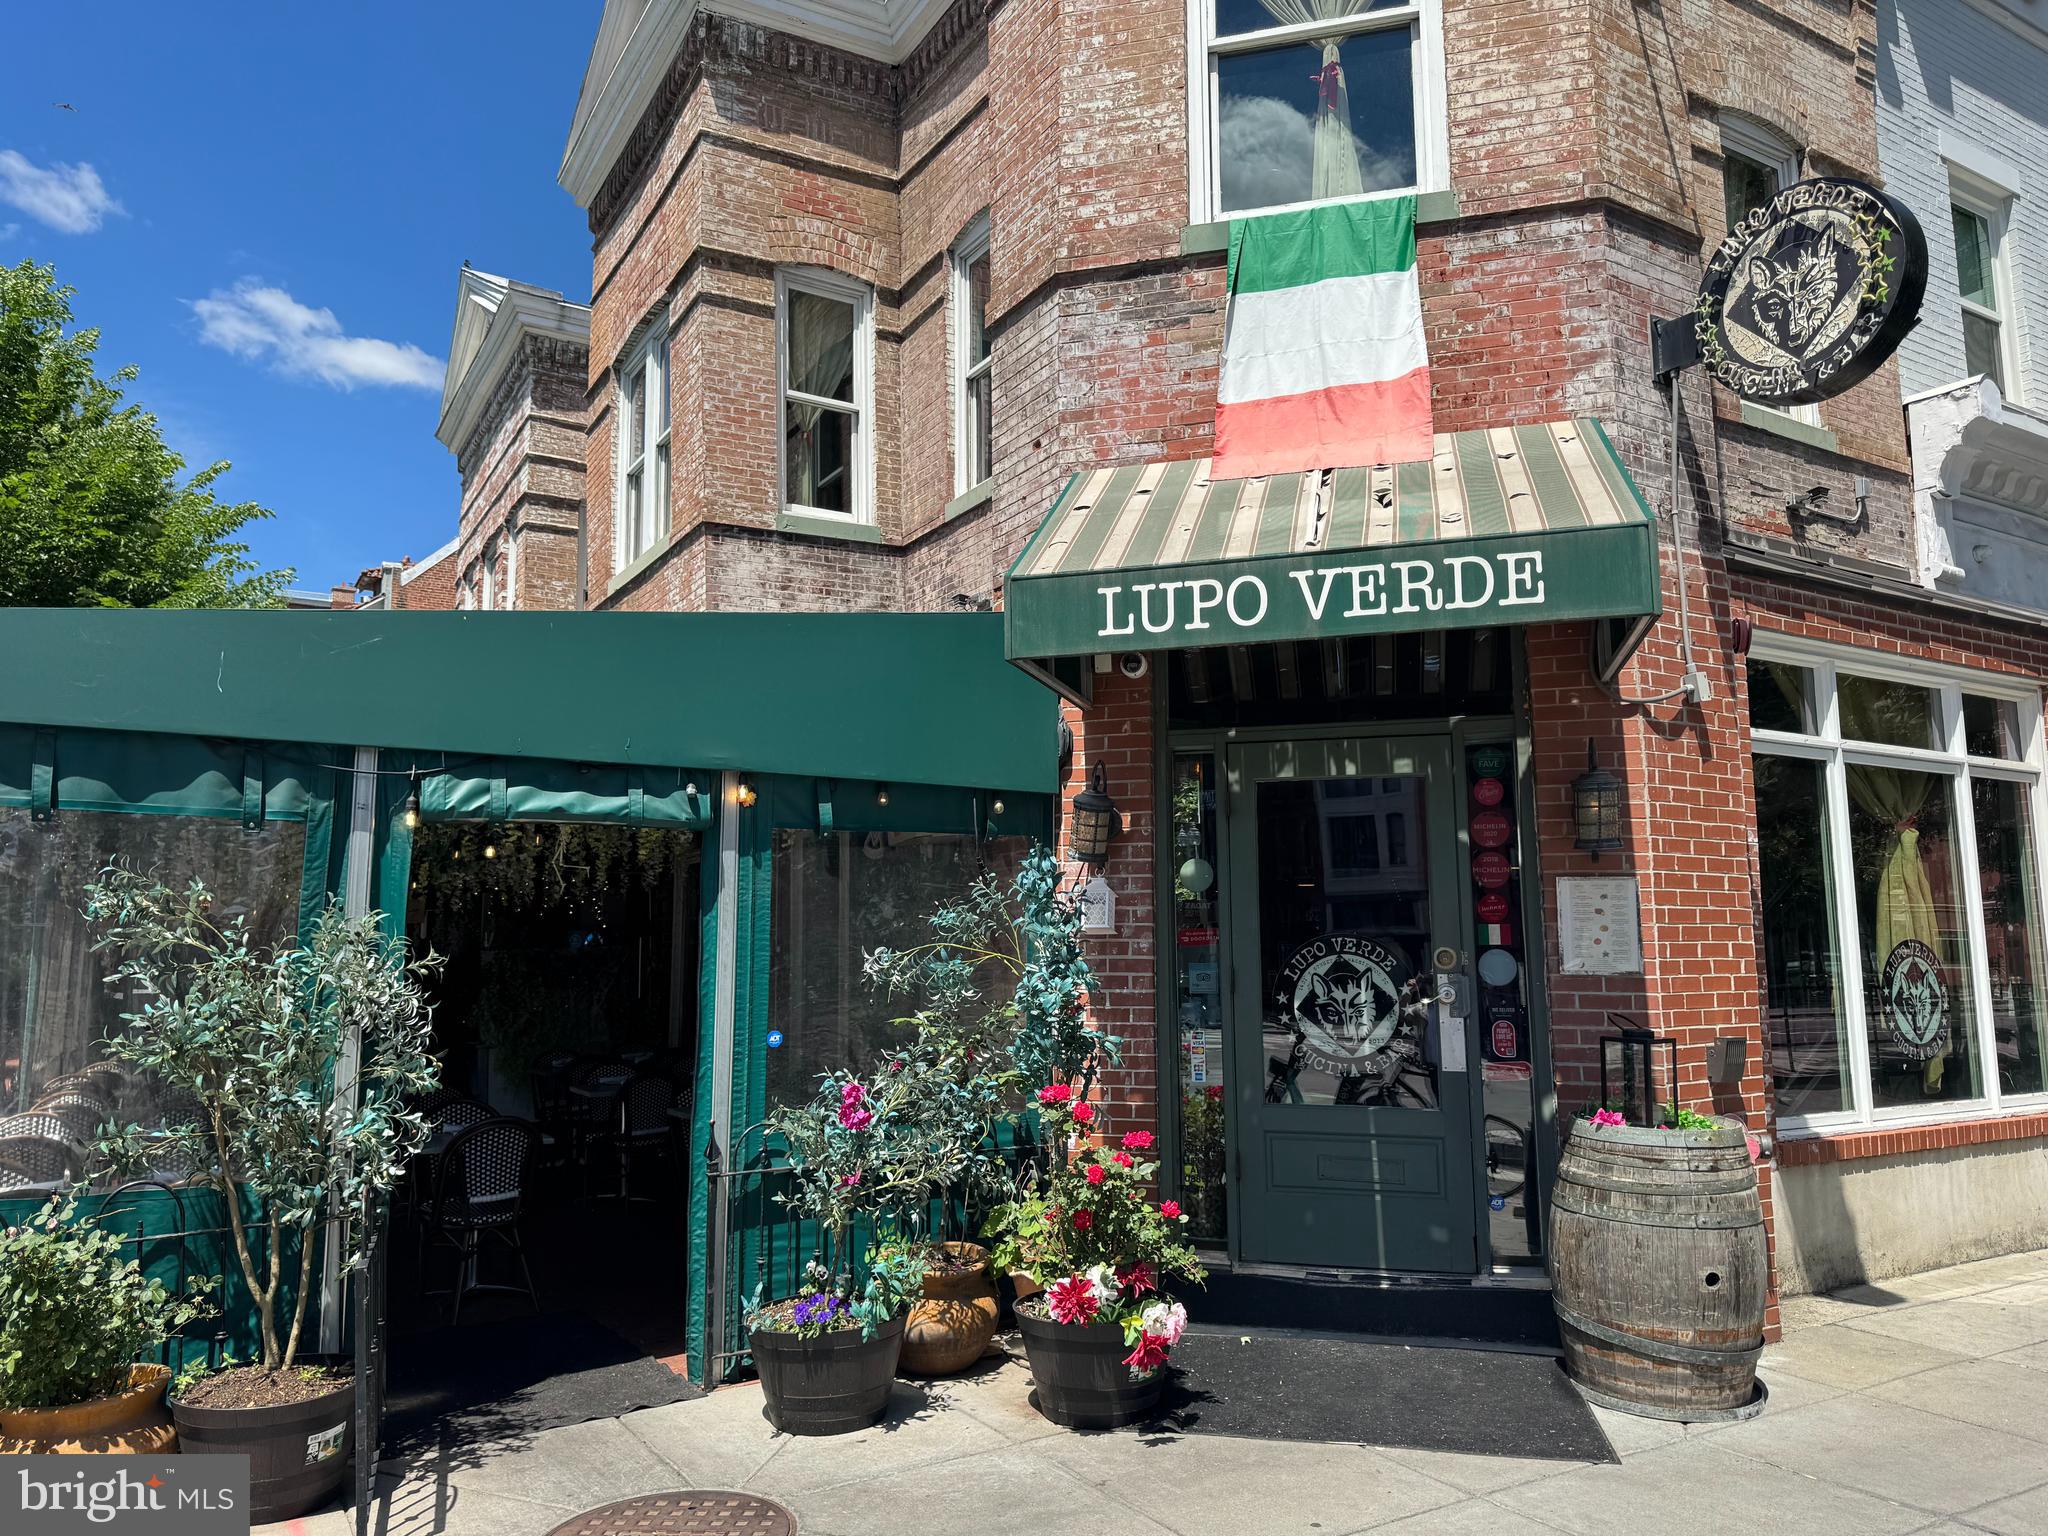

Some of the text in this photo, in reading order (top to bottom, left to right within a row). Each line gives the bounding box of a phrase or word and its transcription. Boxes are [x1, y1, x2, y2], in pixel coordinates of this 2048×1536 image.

[1710, 207, 1770, 272] LUPO
[1774, 182, 1868, 215] VERDE
[1818, 361, 1835, 379] &
[1098, 550, 1546, 637] LUPO VERDE
[1478, 760, 1500, 768] FAVE
[1472, 866, 1511, 874] MICHELIN
[1284, 937, 1397, 981] LUPO VERDE
[1886, 941, 1941, 978] LUPO VERDE
[1294, 1044, 1361, 1078] CUCINA
[1364, 1060, 1378, 1074] &
